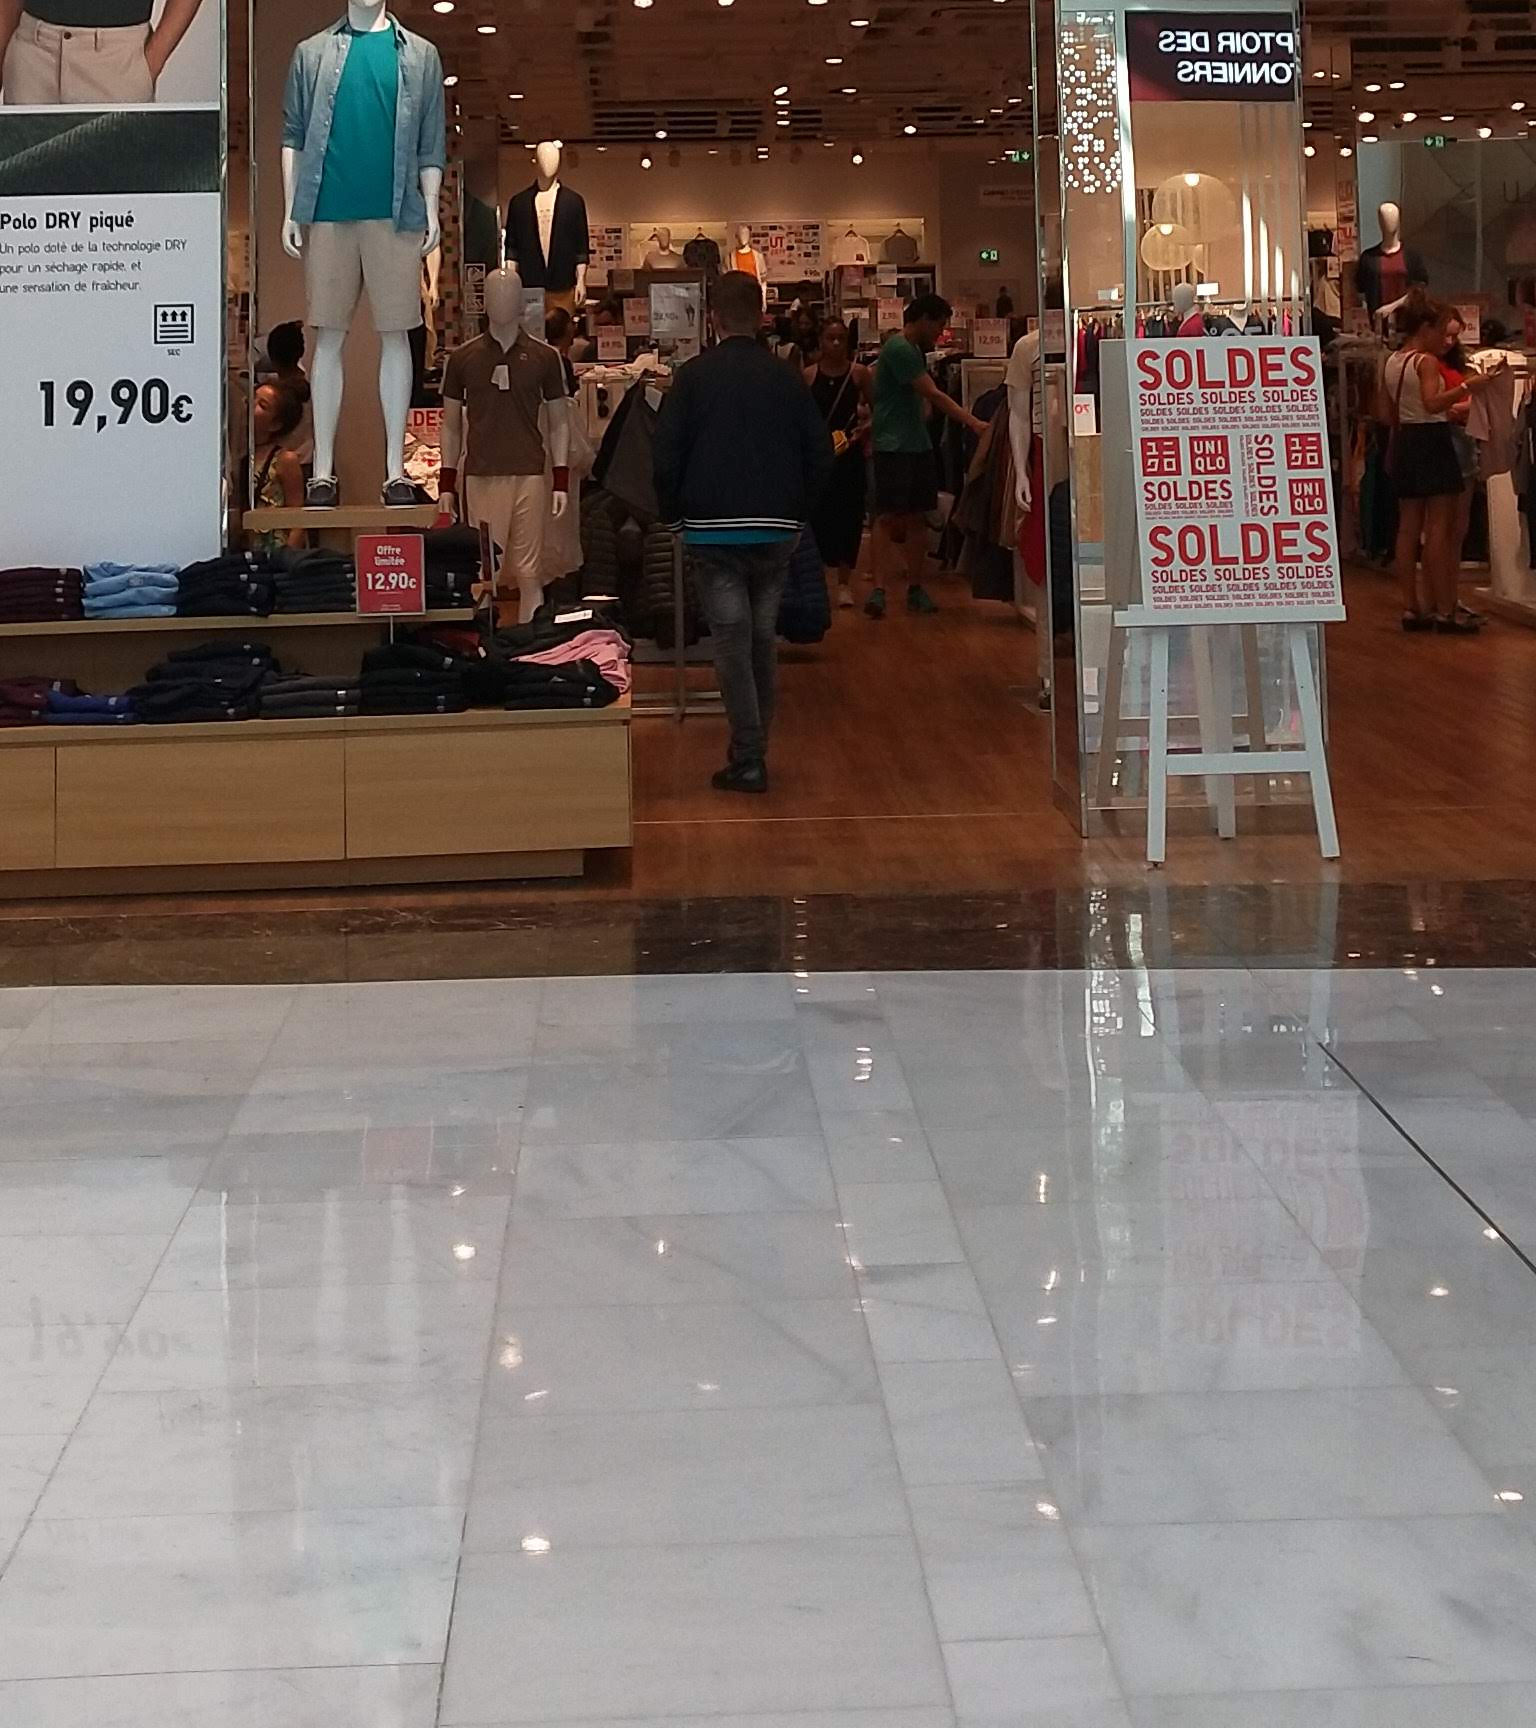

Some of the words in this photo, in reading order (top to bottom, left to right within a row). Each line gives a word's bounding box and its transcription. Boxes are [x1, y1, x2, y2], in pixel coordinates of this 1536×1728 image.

[0, 212, 37, 230] Polo
[45, 211, 81, 229] DRY
[89, 210, 135, 233] piqué
[0, 242, 14, 254] Un
[18, 242, 40, 256] polo
[44, 241, 68, 254] doté
[71, 241, 84, 253] de
[88, 241, 98, 253] la
[102, 239, 161, 255] technologie
[165, 238, 187, 251] DRY
[0, 264, 23, 276] pour
[27, 263, 41, 272] un
[45, 261, 89, 274] séchage
[131, 261, 142, 271] et
[0, 283, 18, 293] une
[22, 281, 70, 293] sensation
[74, 280, 87, 292] de
[1136, 346, 1316, 391] SOLDES
[39, 378, 193, 433] 19,90€
[1139, 392, 1194, 406] SOLDES
[1201, 390, 1256, 405] SOLDES
[1263, 389, 1318, 403] SOLDES
[1140, 407, 1173, 417] SOLDES
[1177, 406, 1209, 416] SOLDES
[1213, 405, 1245, 415] SOLDES
[1249, 405, 1282, 414] SOLDES
[1286, 404, 1319, 413] SOLDES
[1193, 440, 1222, 455] UNI
[1195, 456, 1226, 471] QLO
[1254, 433, 1280, 517] SOLDES
[1143, 479, 1233, 503] SOLDES
[1292, 482, 1320, 497] UNI
[1294, 497, 1324, 513] QLO
[376, 545, 402, 555] Offre
[1148, 520, 1332, 567] SOLDES
[1151, 568, 1207, 583] SOLDES
[1214, 567, 1270, 582] SOLDES
[1278, 565, 1334, 580] SOLDES
[1152, 585, 1185, 595] SOLDES
[1190, 584, 1223, 593] SOLDES
[1226, 583, 1259, 592] SOLDES
[1264, 582, 1297, 591] SOLDES
[1301, 580, 1334, 590] SOLDES
